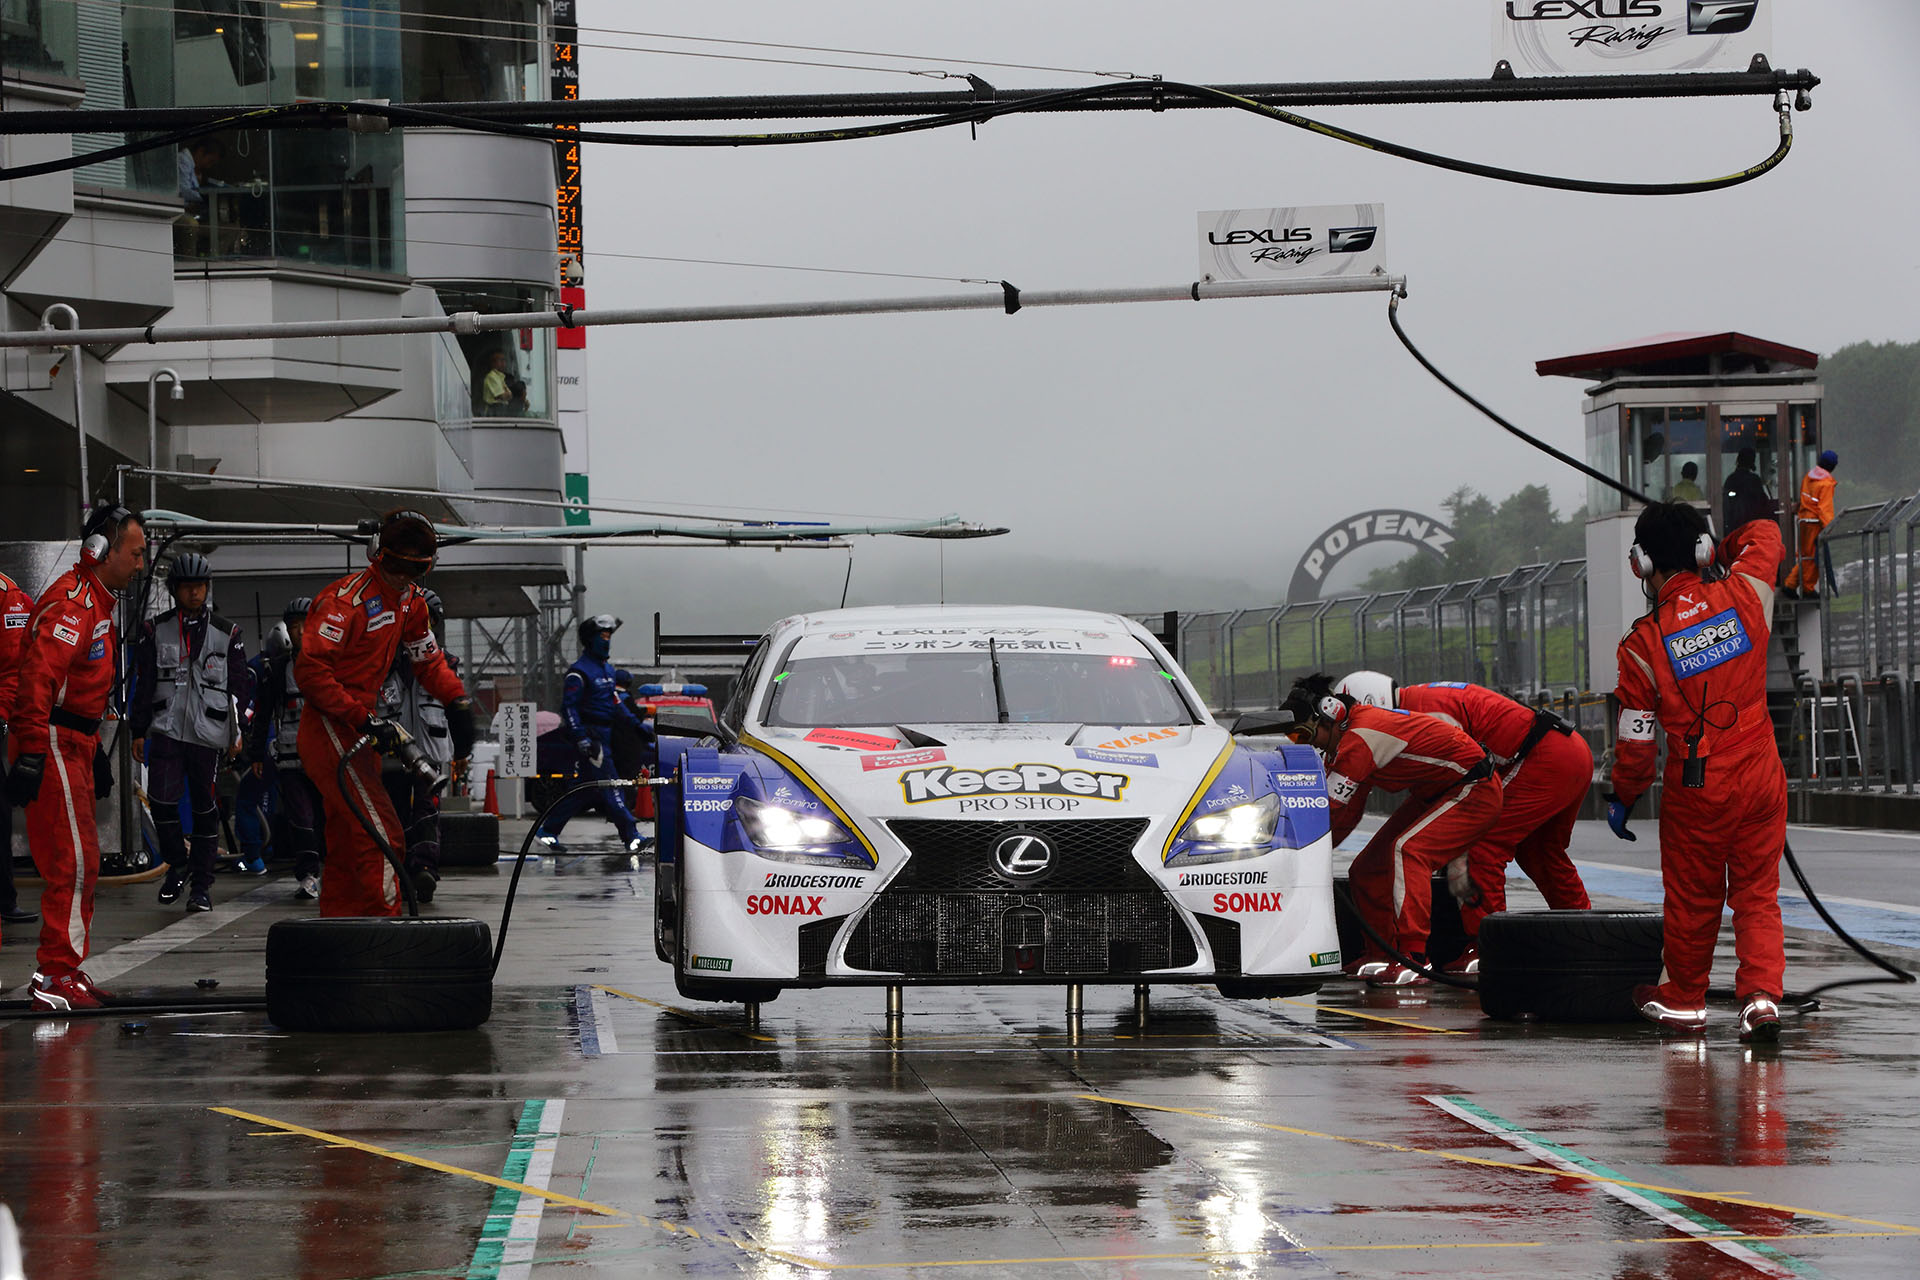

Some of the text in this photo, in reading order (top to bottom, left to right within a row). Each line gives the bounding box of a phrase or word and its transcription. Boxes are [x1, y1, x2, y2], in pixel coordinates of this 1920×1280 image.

[1506, 0, 1663, 20] LEXUS
[1568, 24, 1677, 50] Racing
[562, 66, 578, 79] No.
[564, 85, 577, 100] 3
[566, 145, 579, 163] 4
[567, 165, 580, 183] 7
[557, 206, 577, 224] 31
[1208, 227, 1313, 245] LEXUS
[1250, 246, 1322, 263] Racing
[1303, 513, 1456, 581] POTENZ
[1678, 601, 1708, 621] TOM'S
[1670, 619, 1738, 659] KeePer
[1680, 637, 1742, 673] PRO SHOP
[1632, 718, 1654, 734] 37
[874, 756, 935, 767] LABO
[692, 776, 734, 785] KeePer
[902, 765, 1126, 803] KeePer
[1277, 774, 1318, 782] KeePer
[1334, 782, 1354, 798] 37
[684, 799, 733, 812] EBBRO
[771, 796, 819, 810] promina
[959, 797, 1080, 813] PRO SHOP
[1206, 794, 1249, 809] promina
[764, 873, 866, 888] BRIDGESTONE
[1179, 871, 1268, 886] BRIDGESTONE
[746, 895, 824, 915] SONAX
[1213, 892, 1282, 913] SONAX
